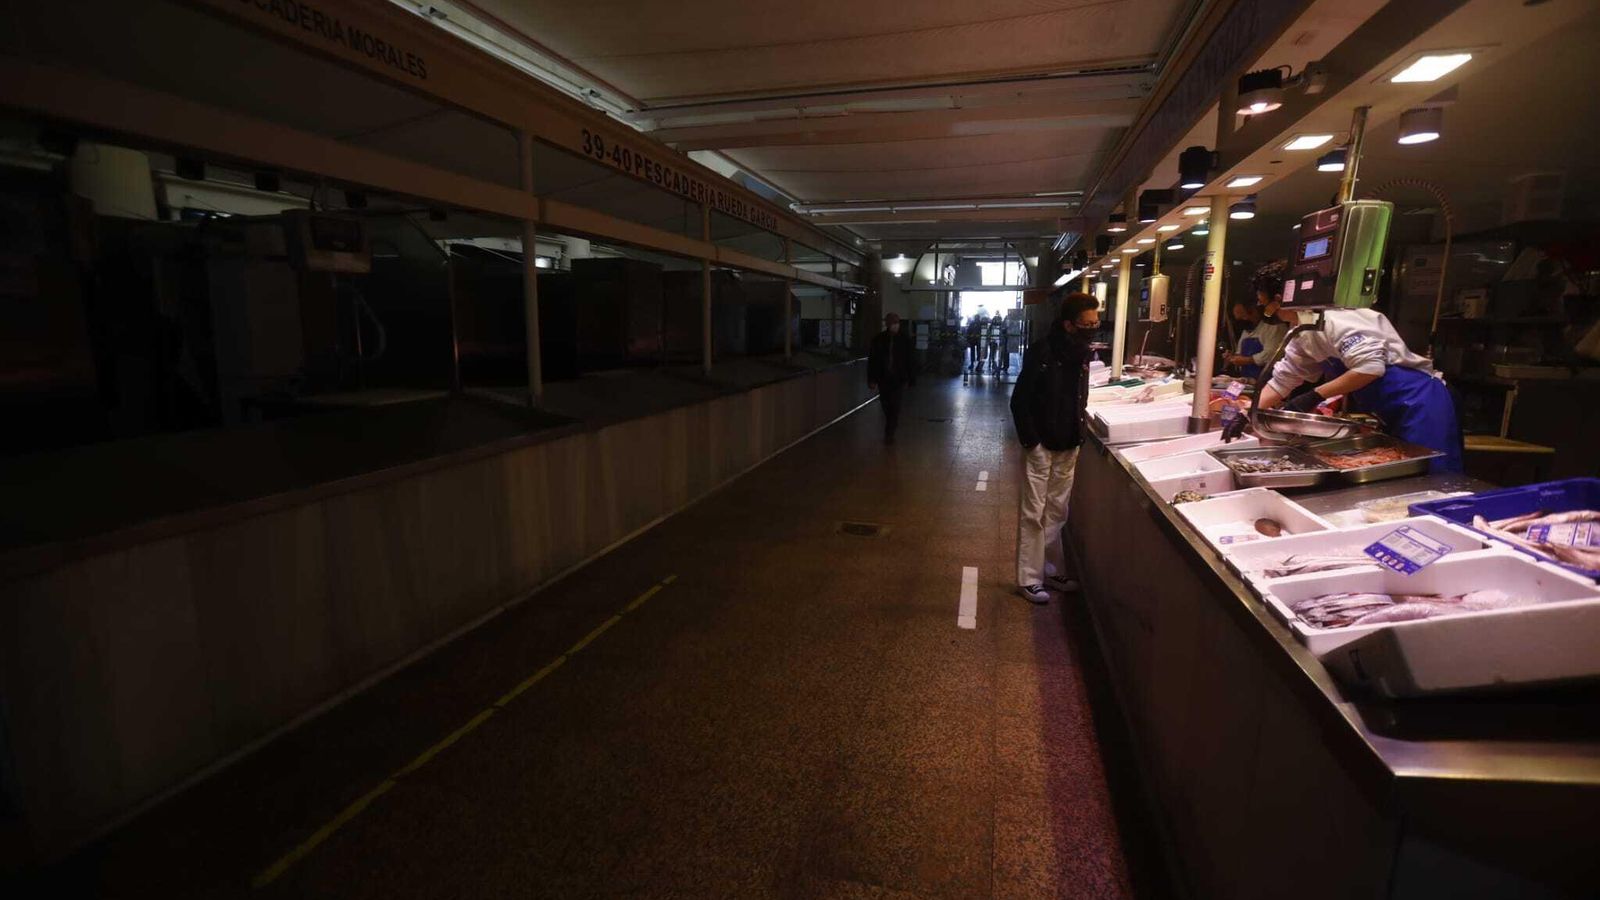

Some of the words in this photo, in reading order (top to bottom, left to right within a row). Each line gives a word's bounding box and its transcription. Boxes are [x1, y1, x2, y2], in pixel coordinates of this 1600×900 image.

[239, 0, 347, 46] ADERIA
[348, 27, 428, 79] MORALES
[581, 128, 632, 171] 39-40
[717, 191, 749, 219] RUEDA
